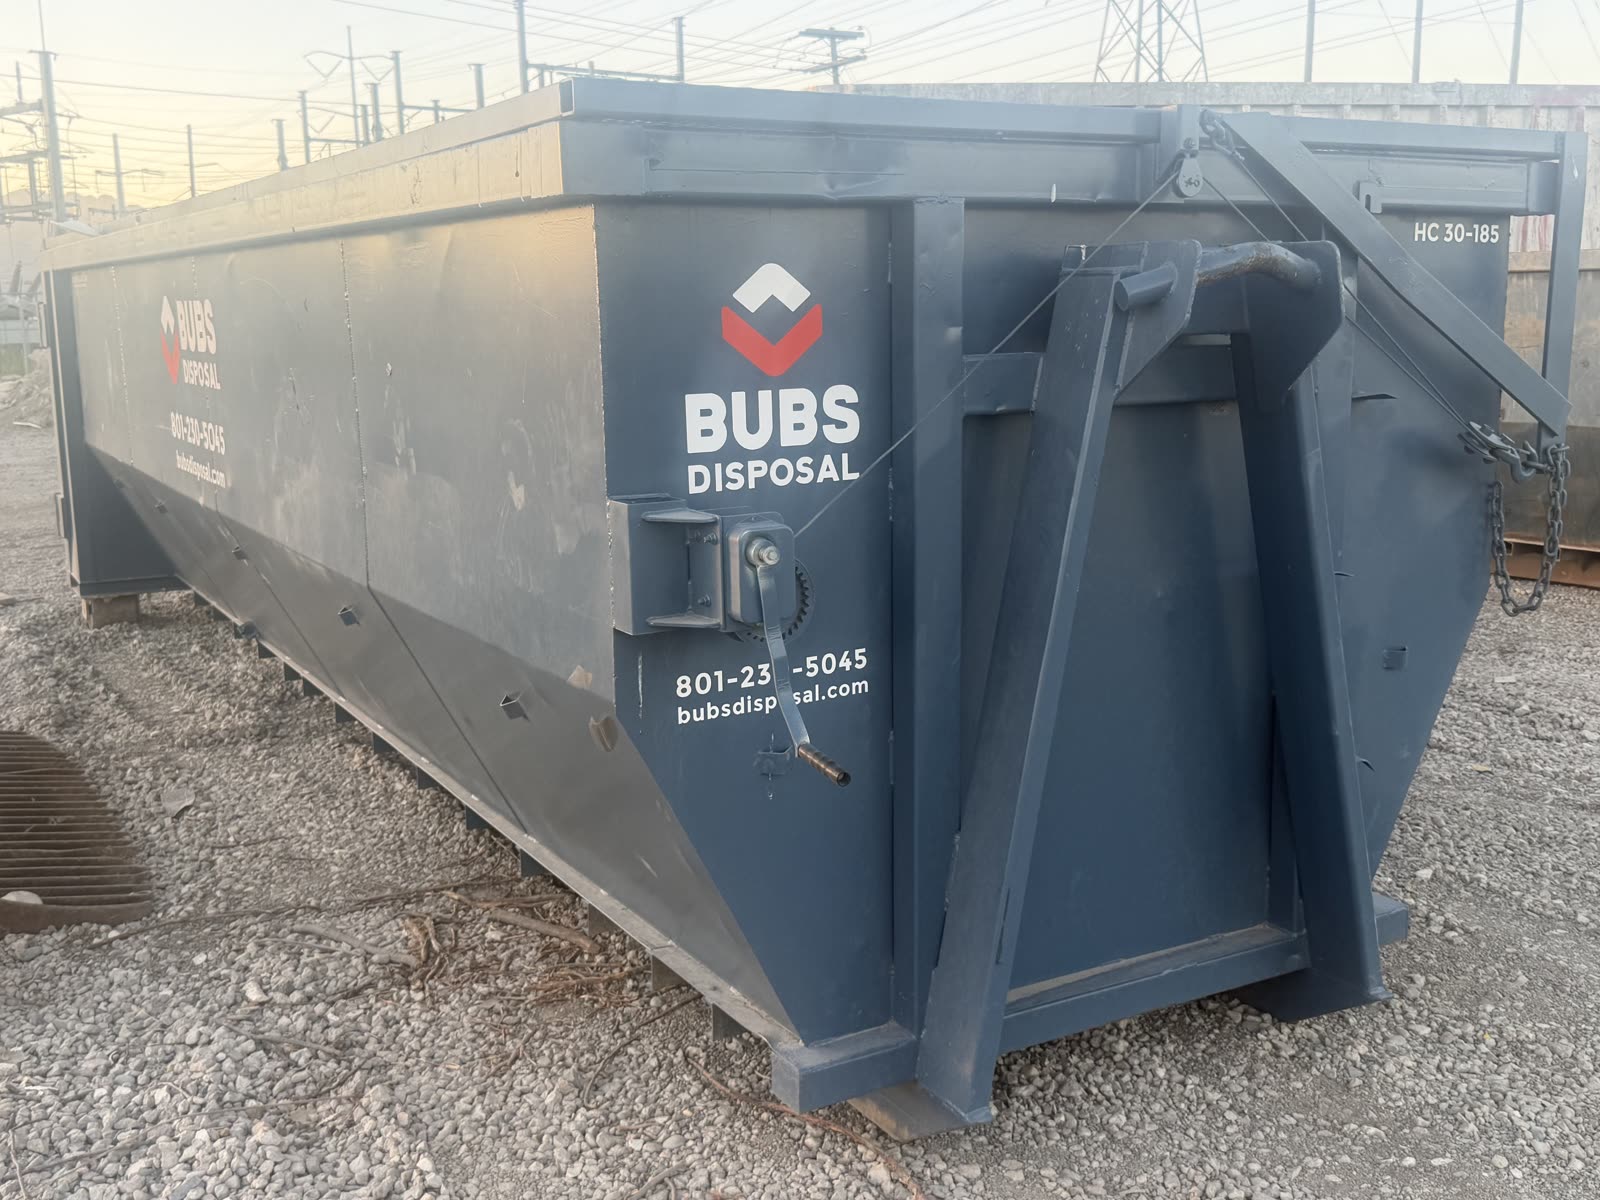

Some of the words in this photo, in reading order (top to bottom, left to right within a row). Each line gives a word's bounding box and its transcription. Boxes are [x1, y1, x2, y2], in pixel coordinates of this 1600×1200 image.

[1414, 222, 1439, 242] HC
[1443, 223, 1500, 244] 30-185
[175, 298, 216, 355] BUBS
[182, 359, 221, 390] DISPOSAL
[170, 411, 226, 456] 801-230-5045
[684, 384, 860, 454] BUBS
[687, 452, 860, 495] DISPOSAL
[675, 647, 868, 698] 801-23-5045
[677, 679, 869, 725] bubsdispsal.com
